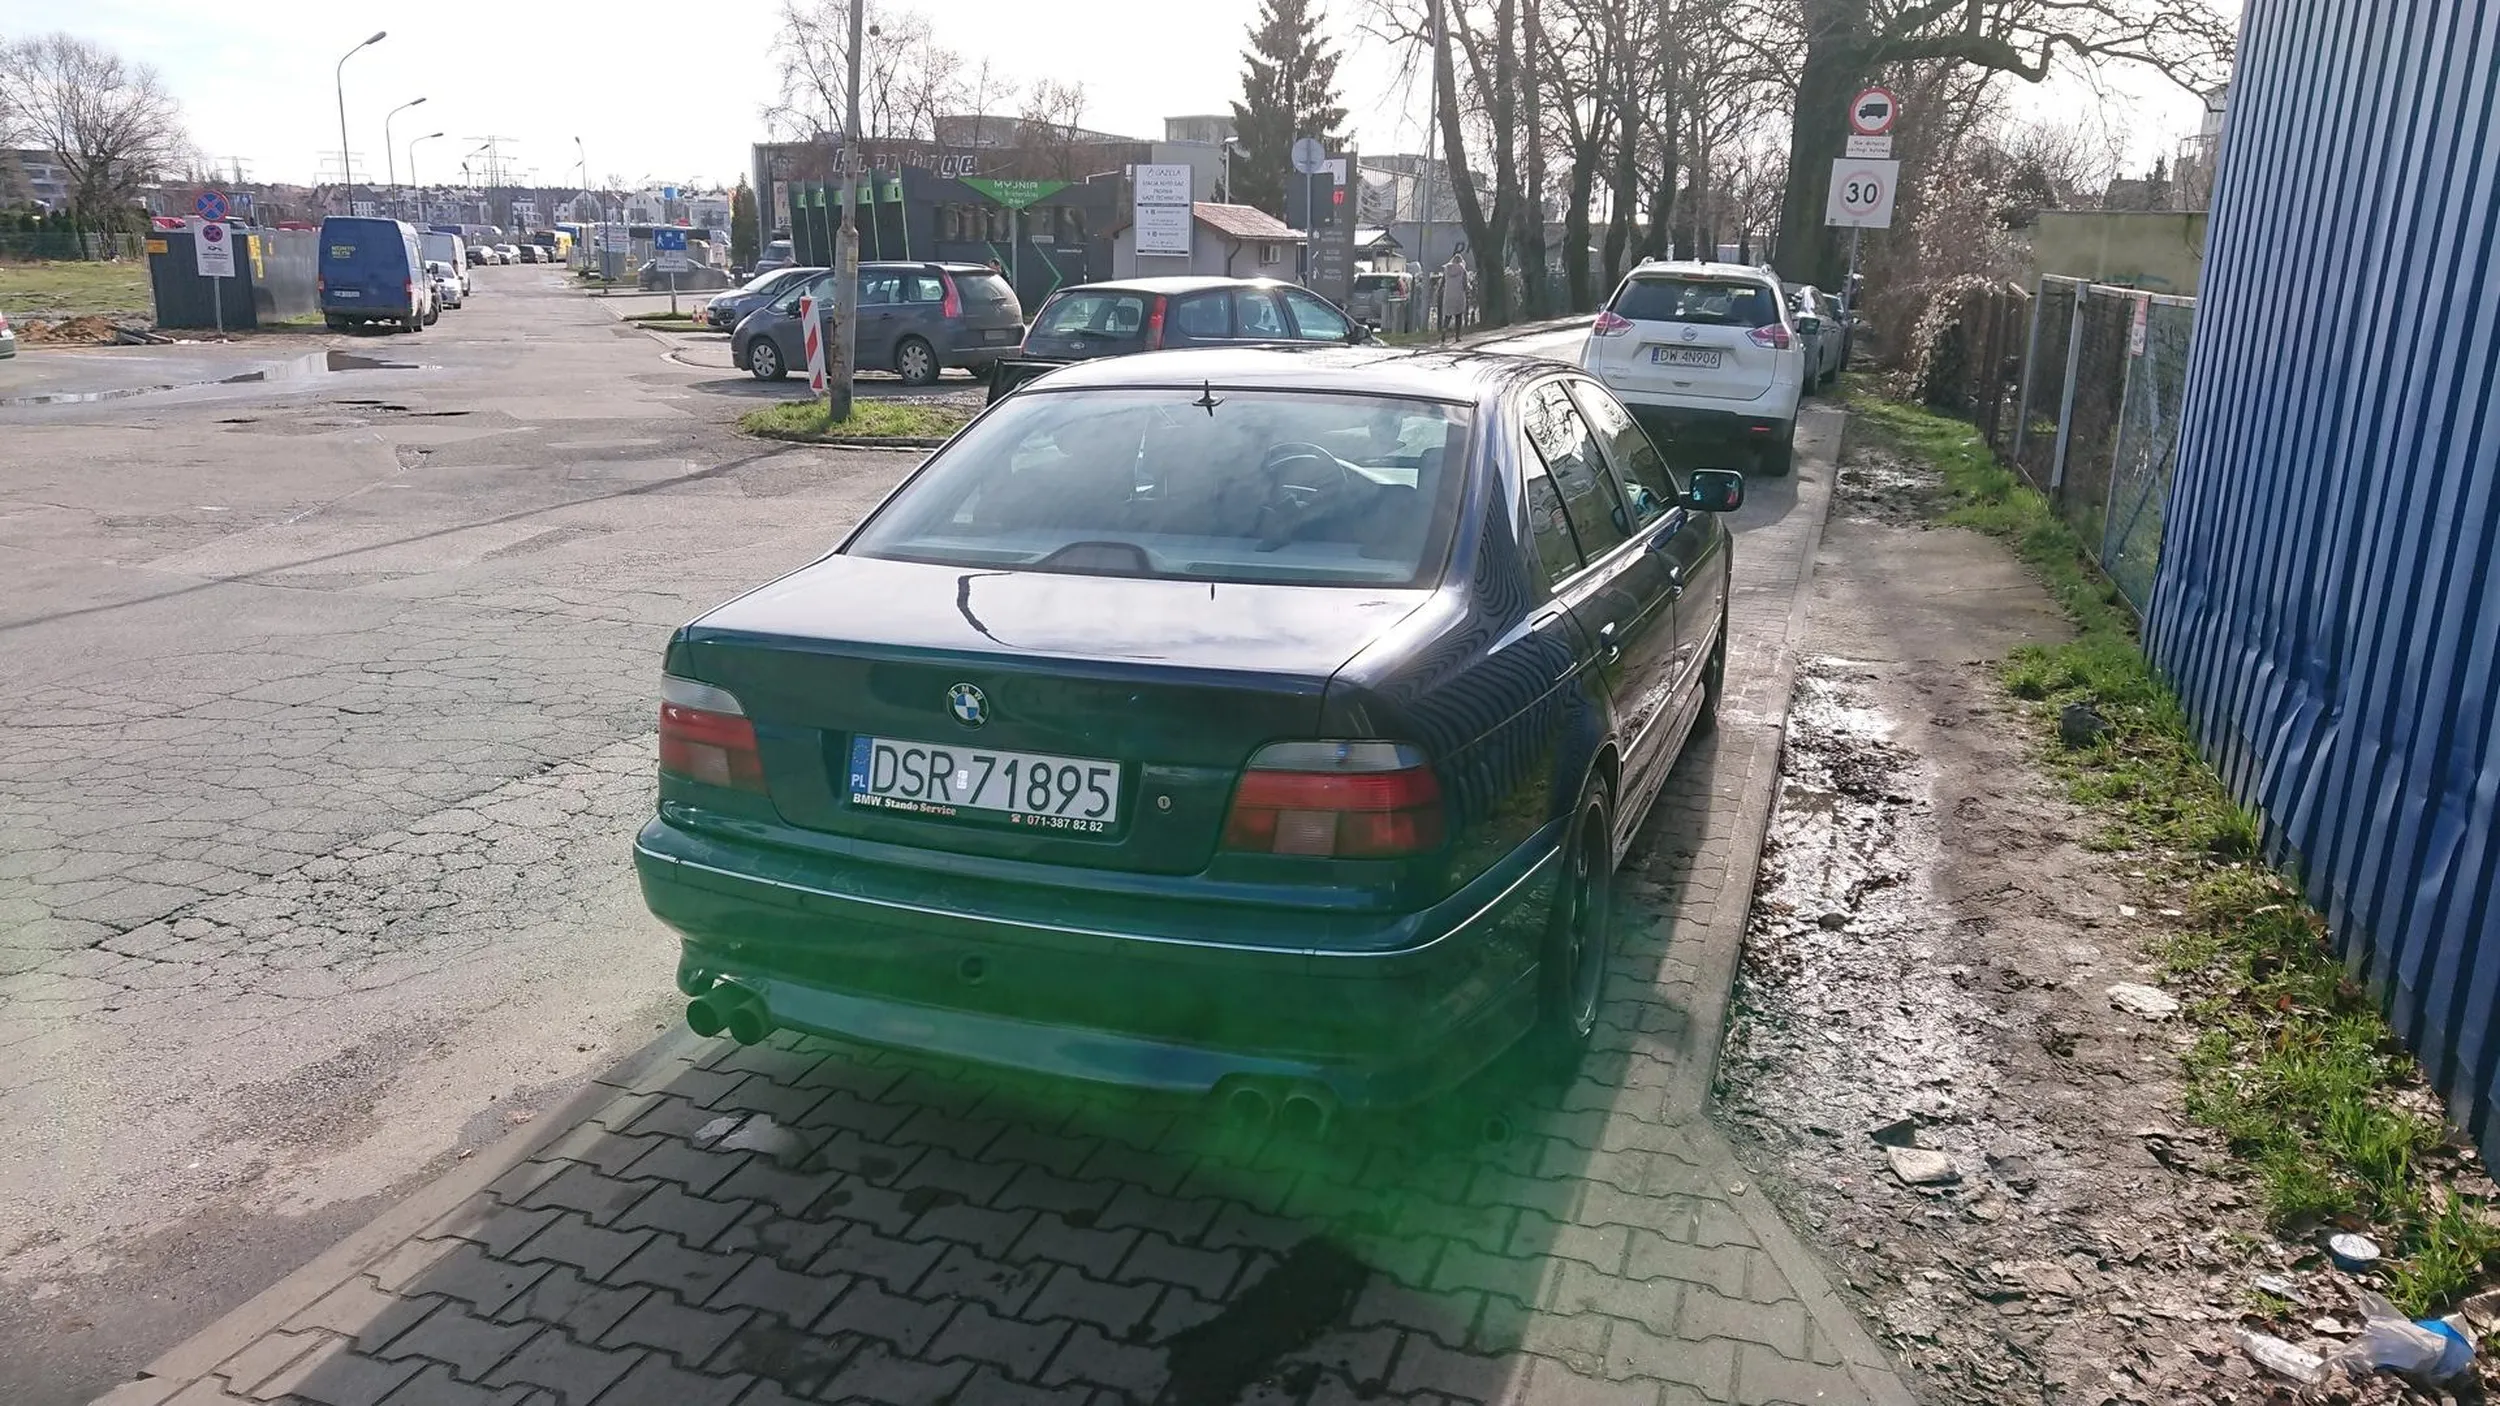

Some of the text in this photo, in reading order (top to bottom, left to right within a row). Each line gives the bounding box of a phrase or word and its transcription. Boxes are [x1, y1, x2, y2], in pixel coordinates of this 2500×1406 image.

[1845, 182, 1878, 204] 30
[1660, 349, 1678, 362] DW
[1681, 351, 1718, 365] 4N906
[851, 773, 866, 788] PL
[871, 744, 1111, 818] DSR 71895
[853, 793, 956, 816] BMW Stando Service
[1027, 815, 1103, 833] 071-387 82 82
